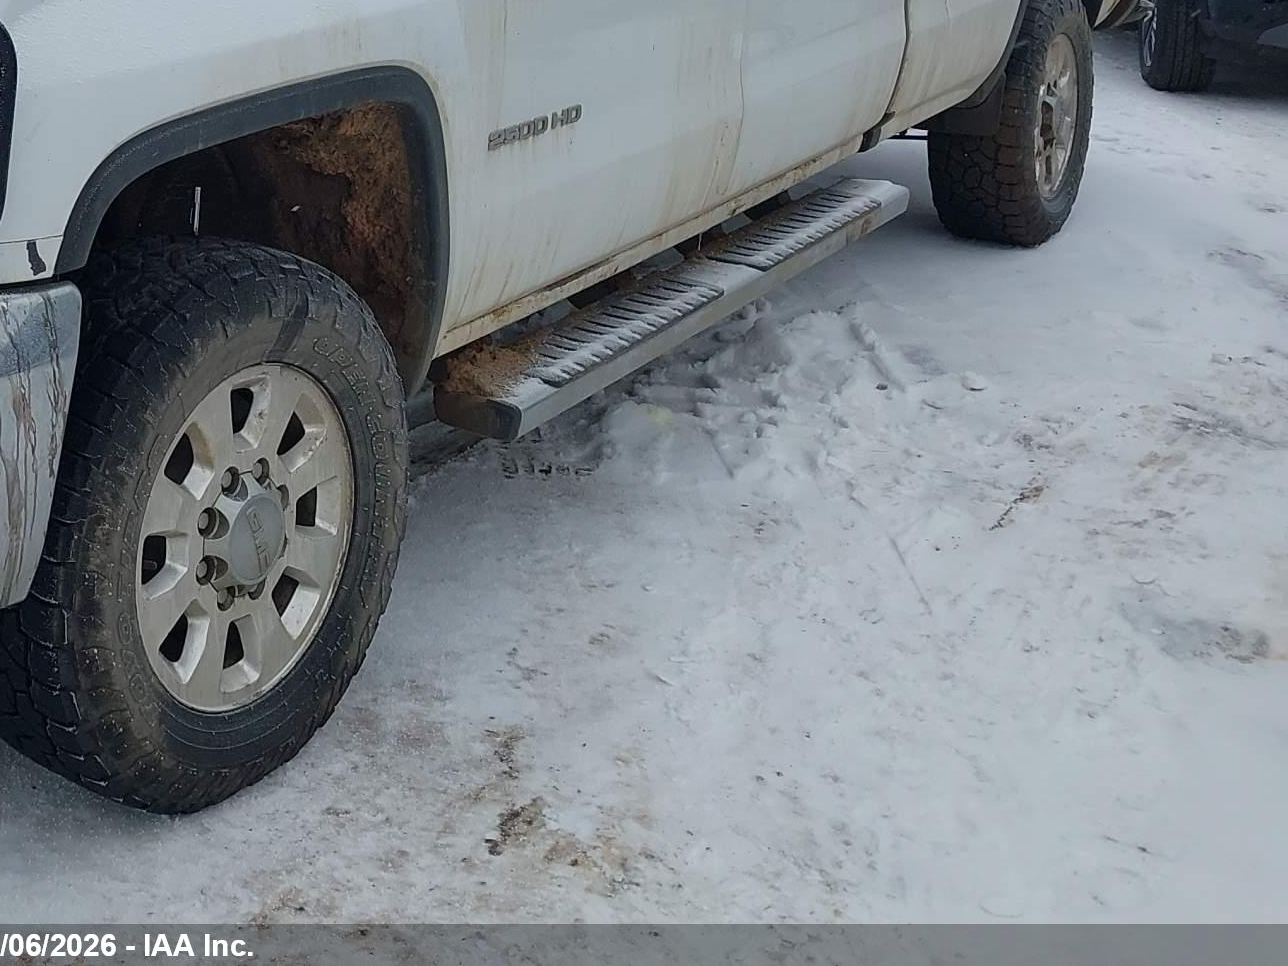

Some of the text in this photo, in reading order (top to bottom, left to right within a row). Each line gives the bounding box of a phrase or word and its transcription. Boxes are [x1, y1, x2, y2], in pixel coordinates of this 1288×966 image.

[488, 104, 582, 152] 2500 HD
[246, 506, 272, 575] GMC
